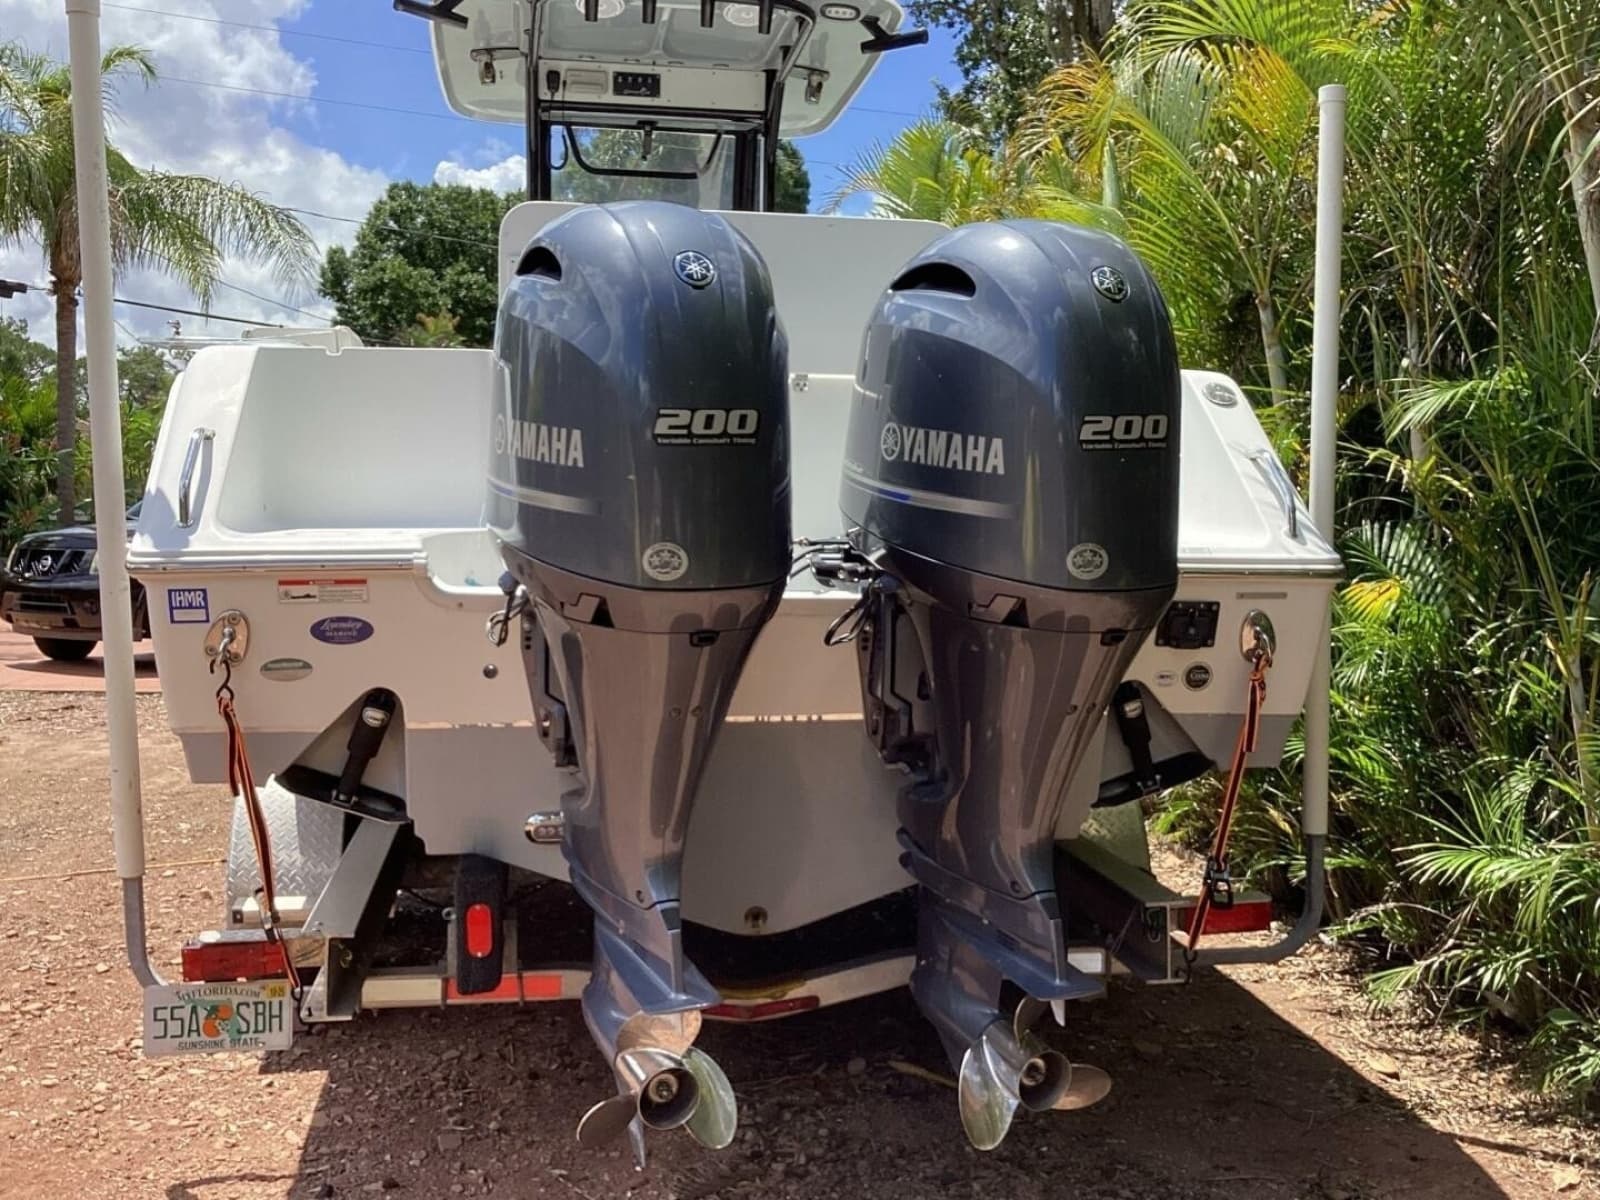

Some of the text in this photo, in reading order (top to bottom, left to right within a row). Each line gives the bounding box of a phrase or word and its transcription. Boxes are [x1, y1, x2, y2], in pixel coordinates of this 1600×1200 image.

[654, 409, 759, 434] 200
[1080, 414, 1168, 440] 200
[507, 419, 584, 467] YAMAHA
[902, 426, 1005, 475] YAMAHA
[171, 590, 205, 608] IHMR
[152, 999, 283, 1039] 55A SBH
[178, 1037, 260, 1051] SUNSHINE STATE
